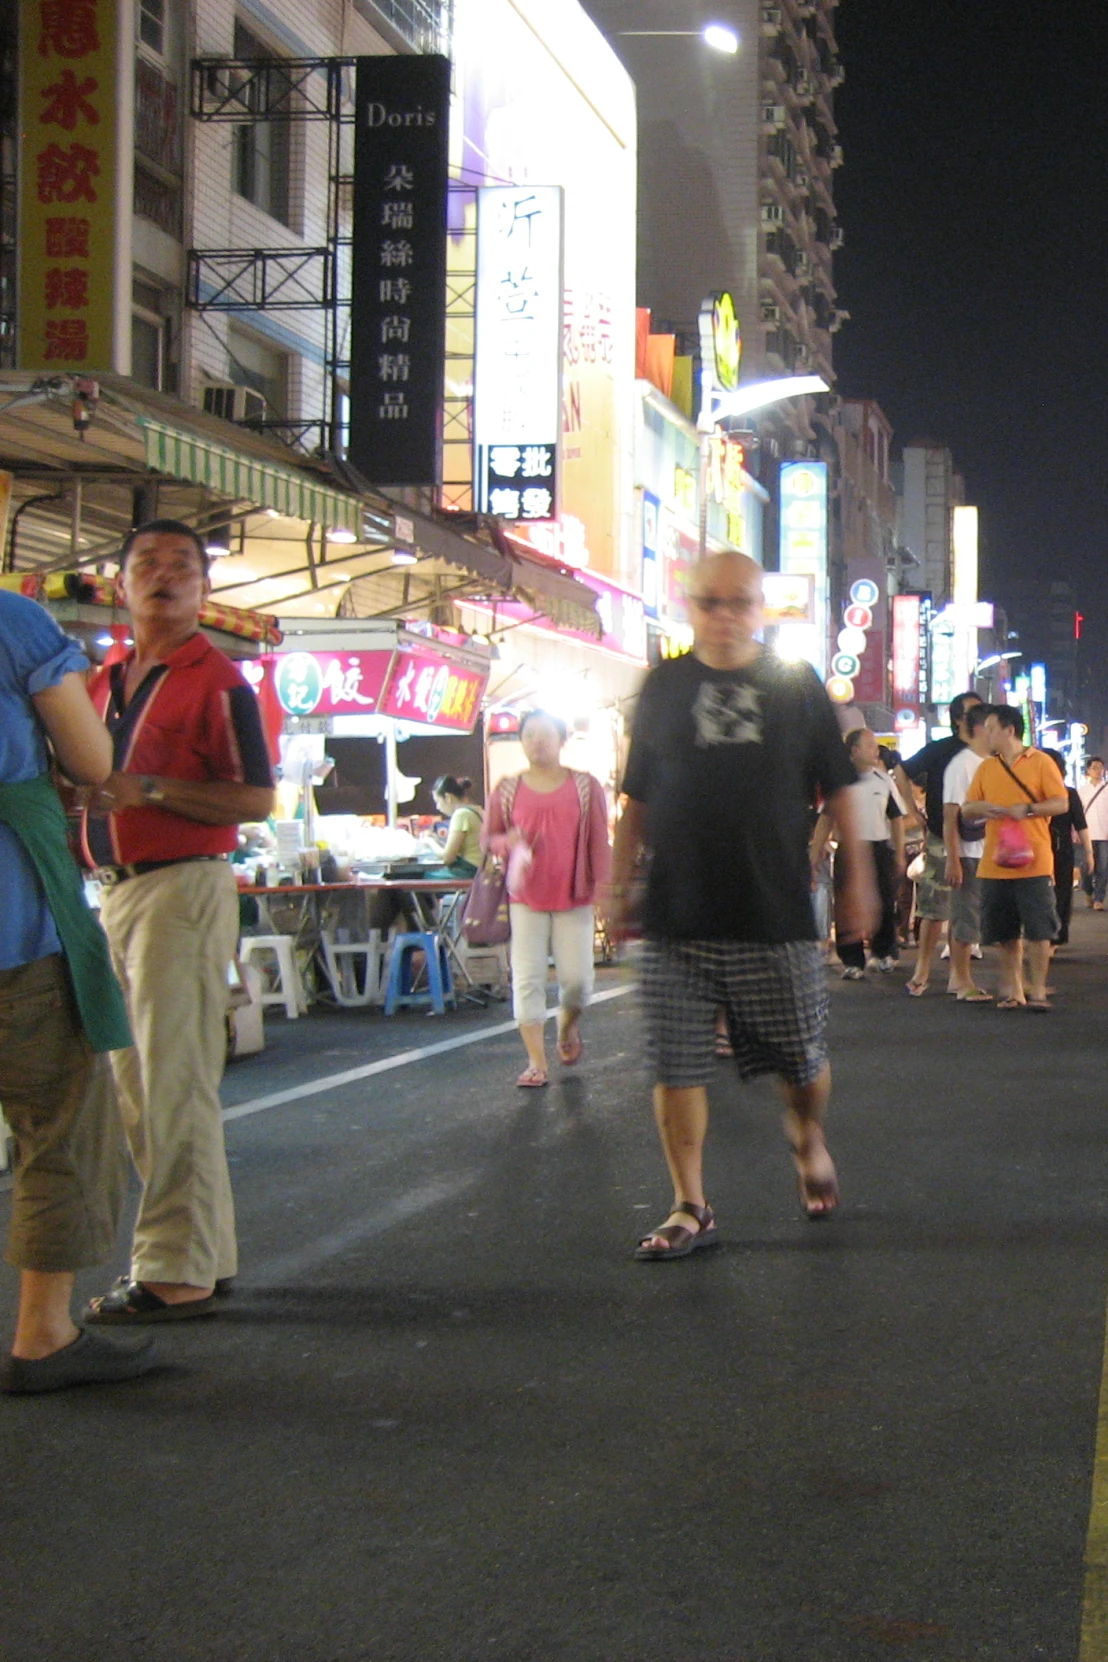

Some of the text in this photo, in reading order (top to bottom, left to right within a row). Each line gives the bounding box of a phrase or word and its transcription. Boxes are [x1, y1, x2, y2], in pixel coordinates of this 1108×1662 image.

[366, 102, 436, 127] Doris
[378, 164, 414, 420] 朵瑞絲時尚精品
